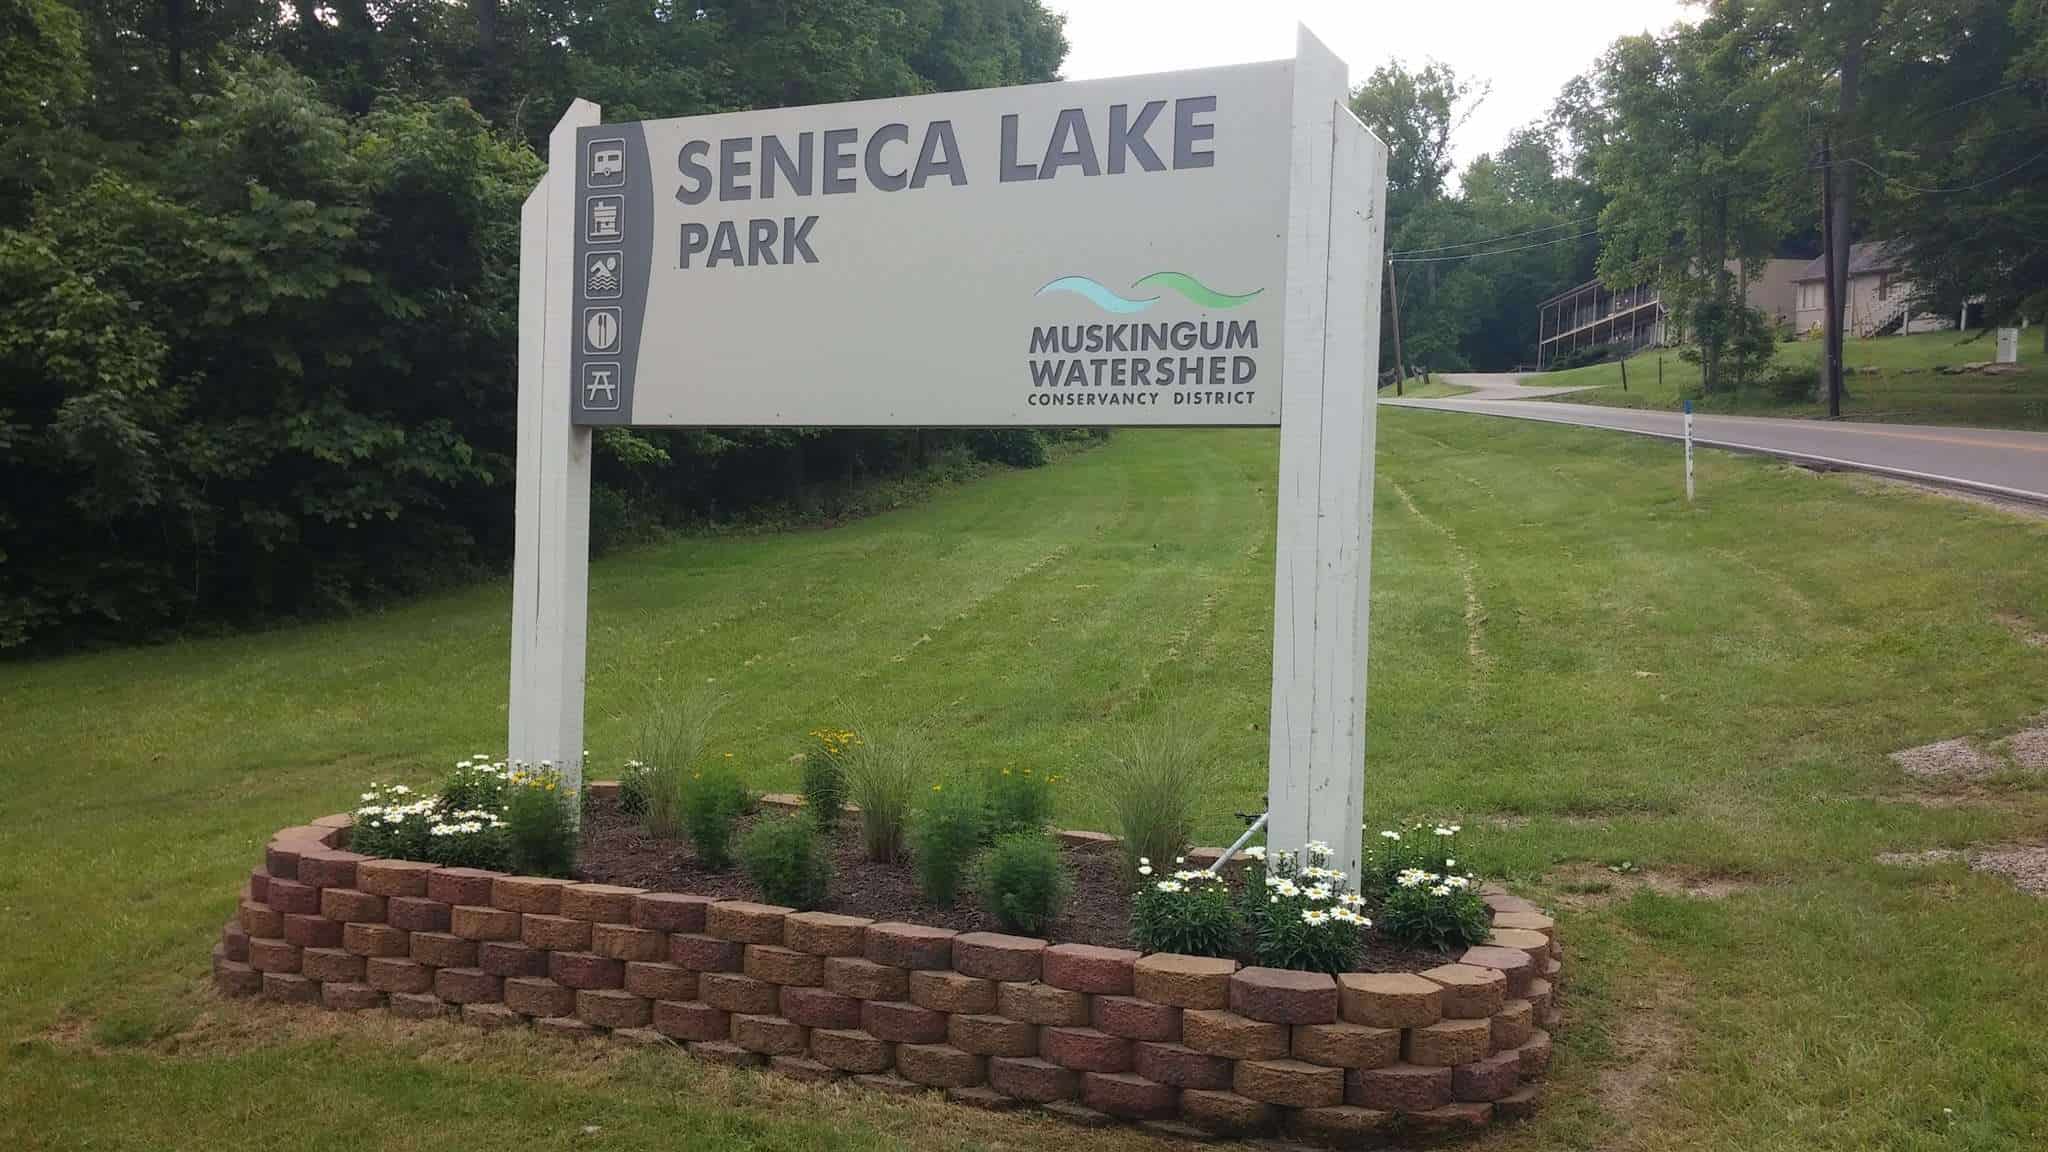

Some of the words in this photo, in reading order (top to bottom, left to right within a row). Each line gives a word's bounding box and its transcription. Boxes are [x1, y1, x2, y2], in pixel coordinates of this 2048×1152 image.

[674, 118, 967, 206] SENECA
[1000, 95, 1216, 183] LAKE
[679, 215, 820, 270] PARK
[1028, 319, 1259, 354] MUSKINGUM
[1028, 355, 1257, 387] WATERSHED
[1028, 392, 1160, 406] CONSERVANCY
[1173, 391, 1256, 405] DISTRICT
